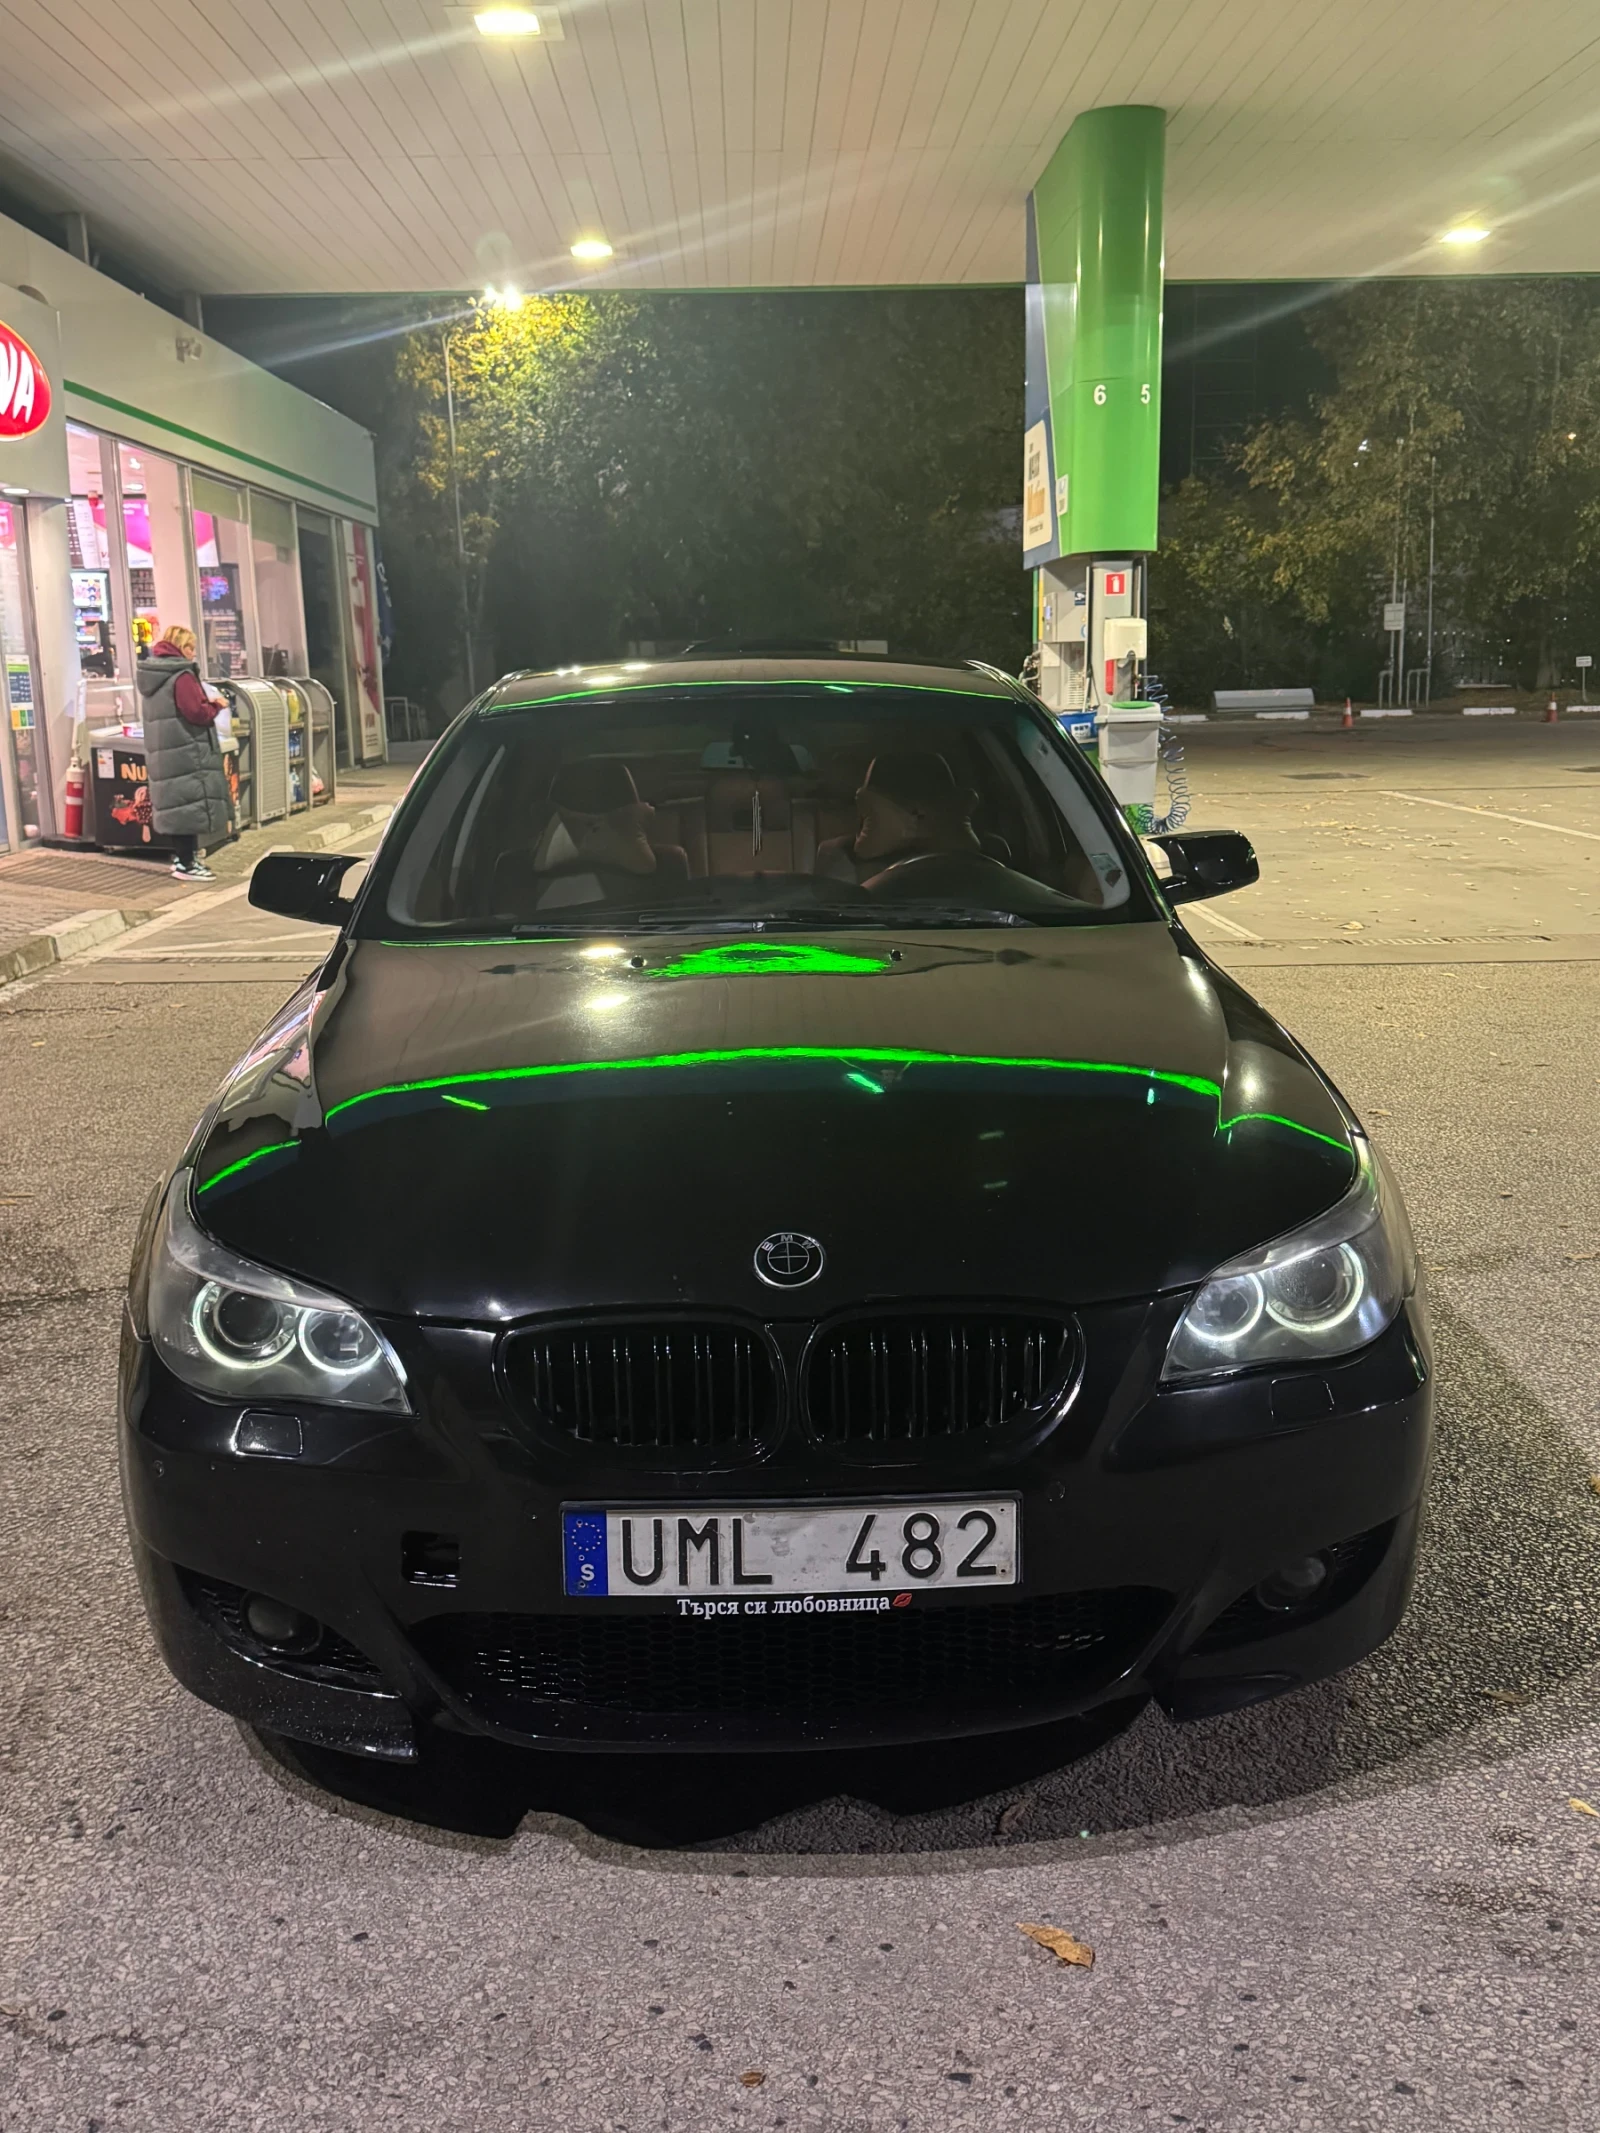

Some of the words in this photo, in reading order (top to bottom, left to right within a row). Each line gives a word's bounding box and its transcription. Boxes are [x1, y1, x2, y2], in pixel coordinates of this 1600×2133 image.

[1093, 384, 1107, 406] 6
[1140, 383, 1151, 405] 5
[761, 1234, 816, 1251] BMW
[621, 1517, 773, 1587] UML
[845, 1510, 998, 1582] 482
[580, 1563, 595, 1582] S
[677, 1599, 739, 1619] Търся
[744, 1600, 767, 1615] си
[772, 1596, 890, 1614] любовница
